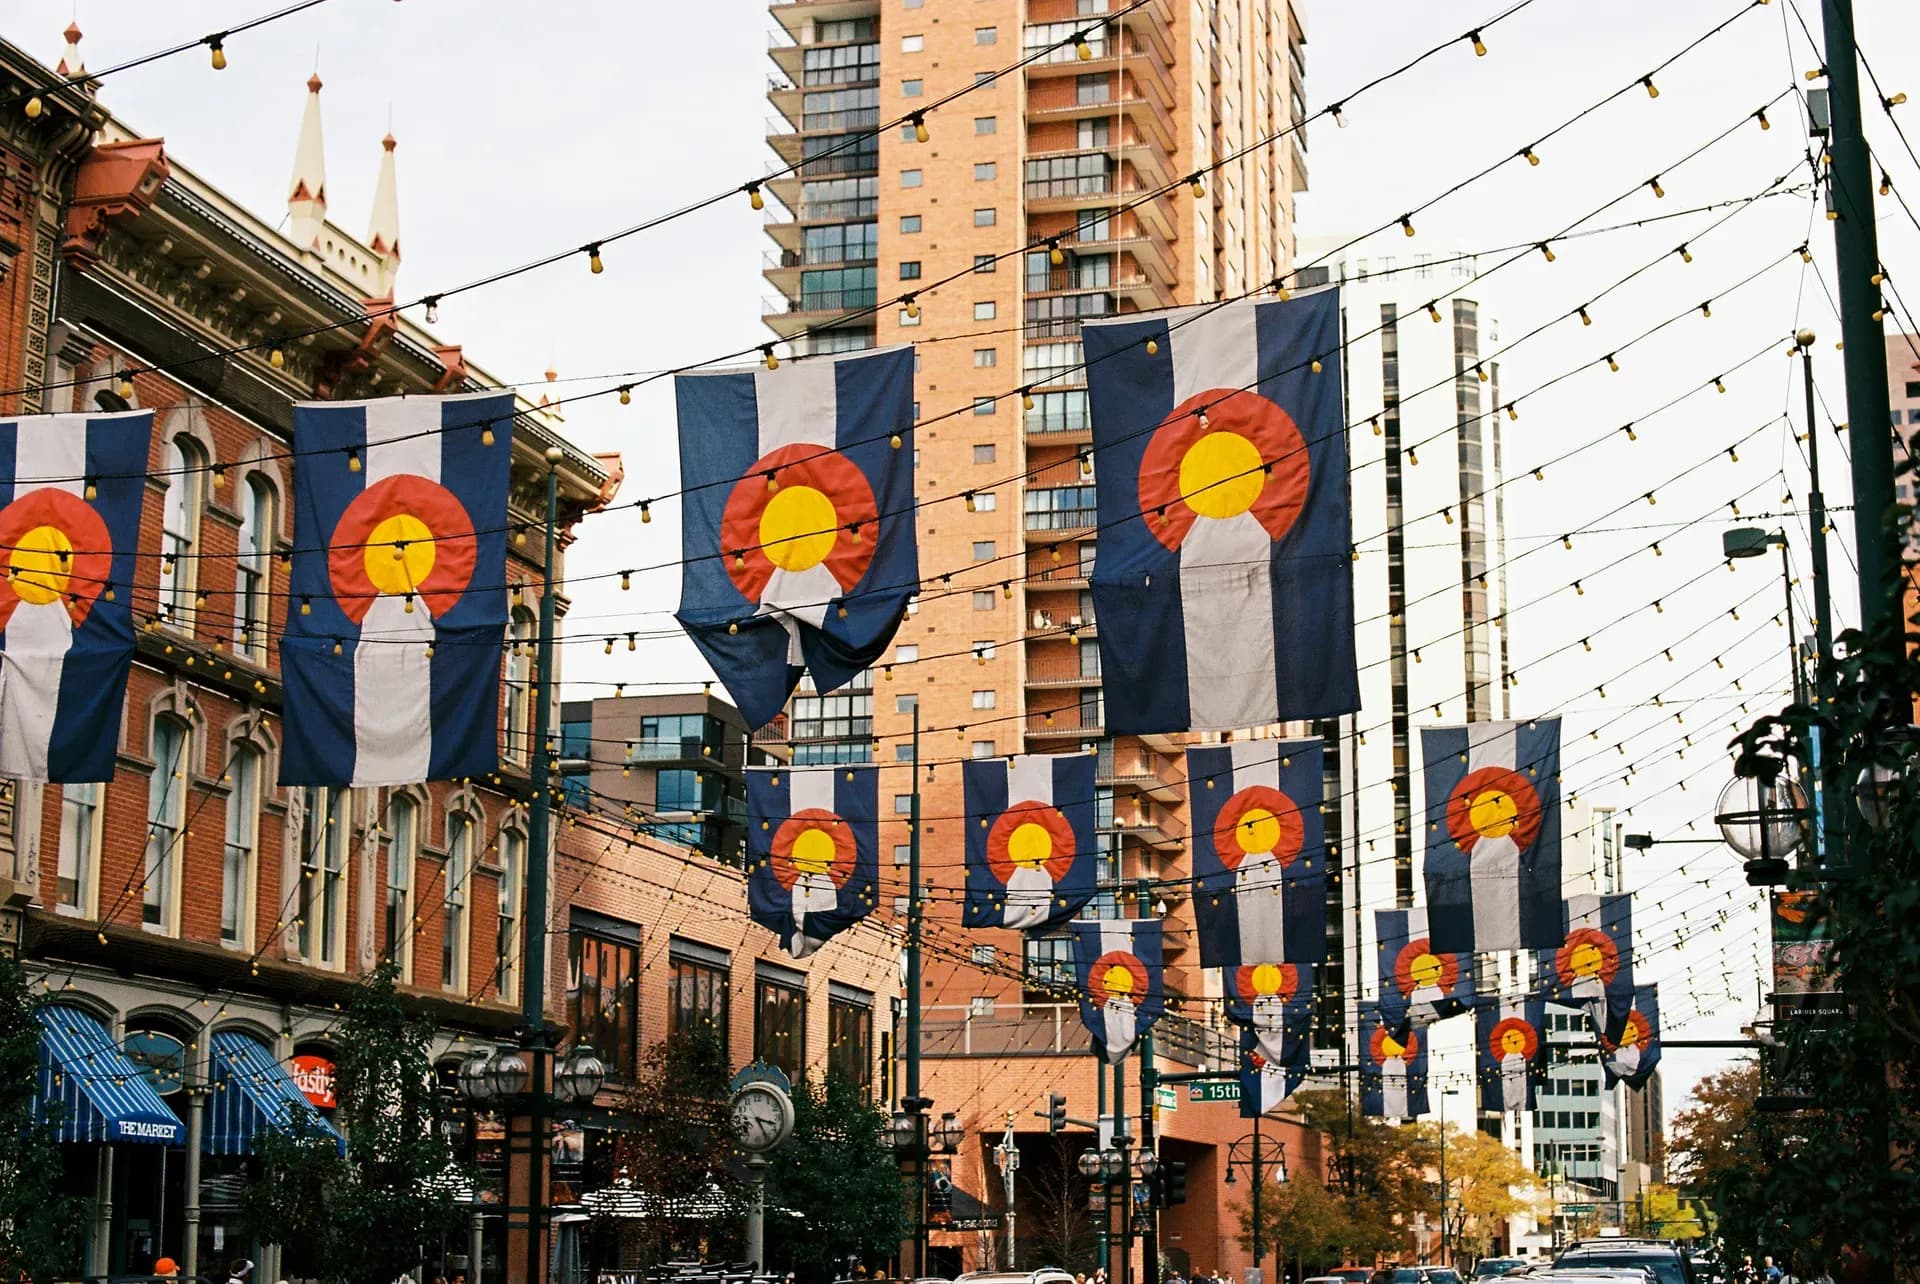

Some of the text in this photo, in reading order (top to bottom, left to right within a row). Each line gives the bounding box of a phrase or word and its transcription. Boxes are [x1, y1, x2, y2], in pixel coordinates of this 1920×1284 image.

[1209, 1084, 1240, 1098] 15th
[118, 1120, 176, 1139] THE MARKET
